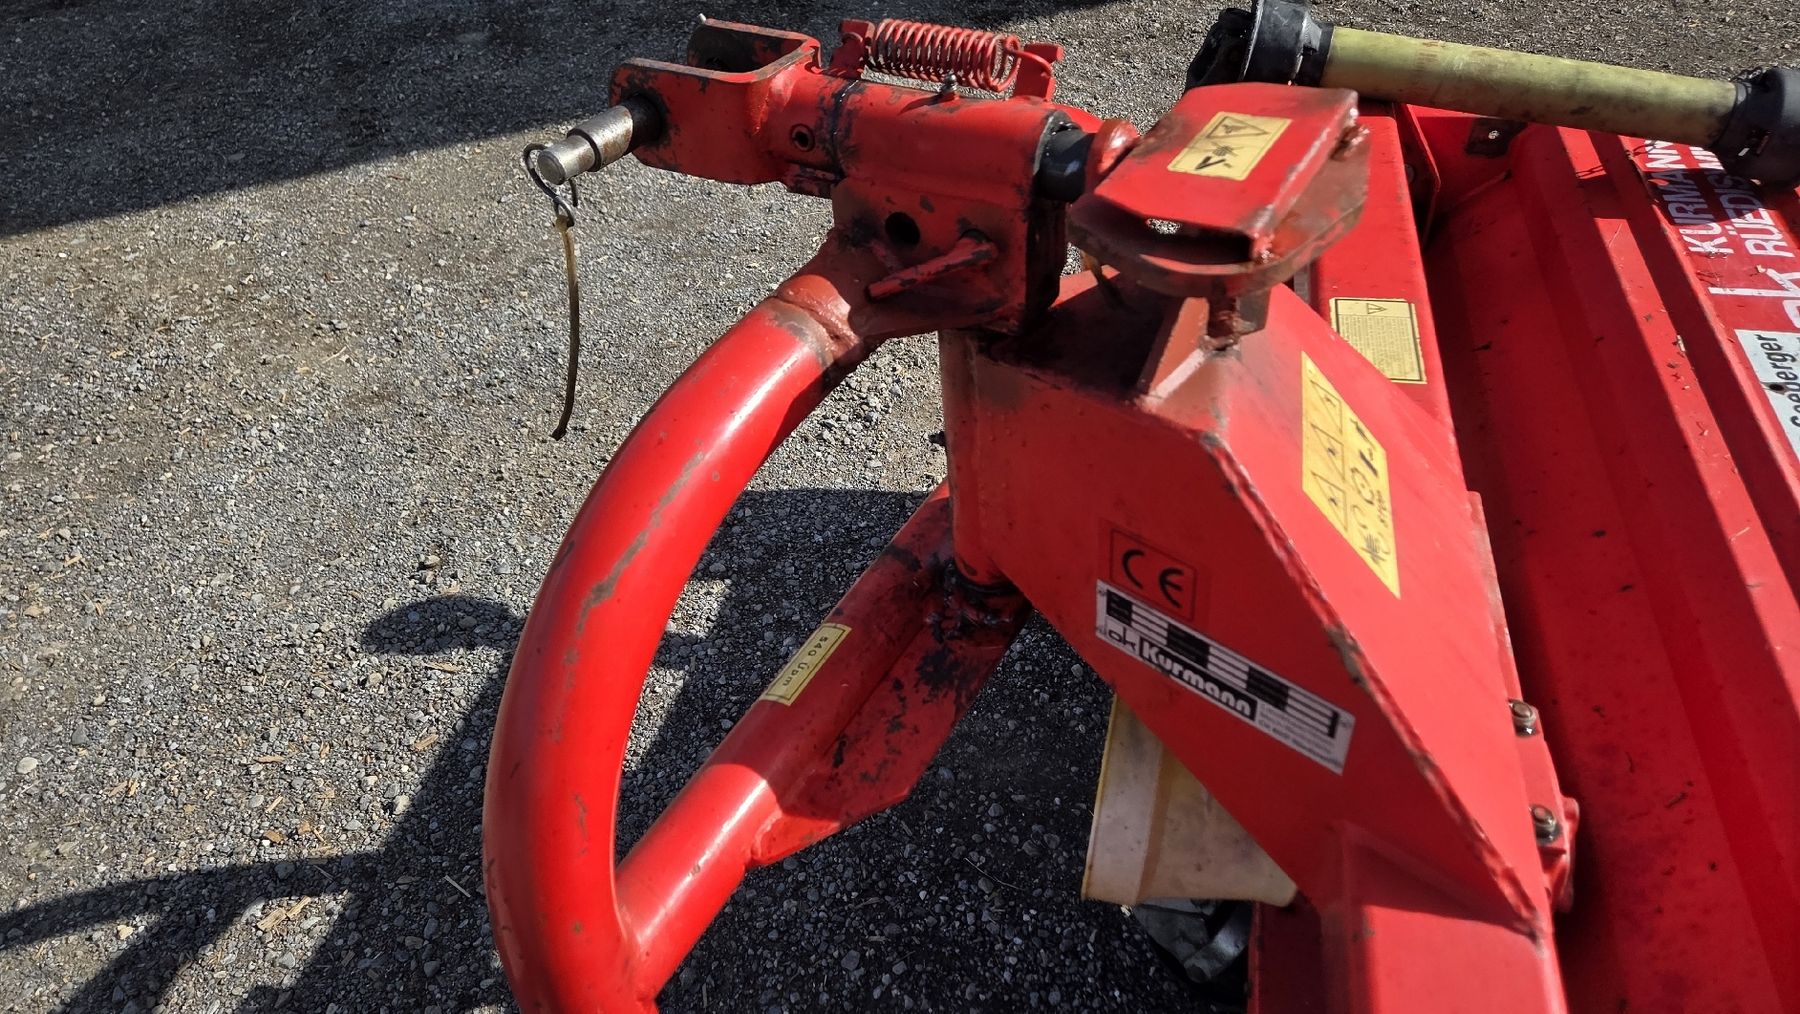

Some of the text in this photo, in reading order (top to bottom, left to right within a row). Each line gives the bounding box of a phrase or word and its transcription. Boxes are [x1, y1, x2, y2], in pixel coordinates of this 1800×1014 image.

[1644, 140, 1734, 254] KURMANN
[1122, 550, 1184, 608] CE
[808, 636, 829, 657] 540
[1142, 639, 1252, 717] Kurmann
